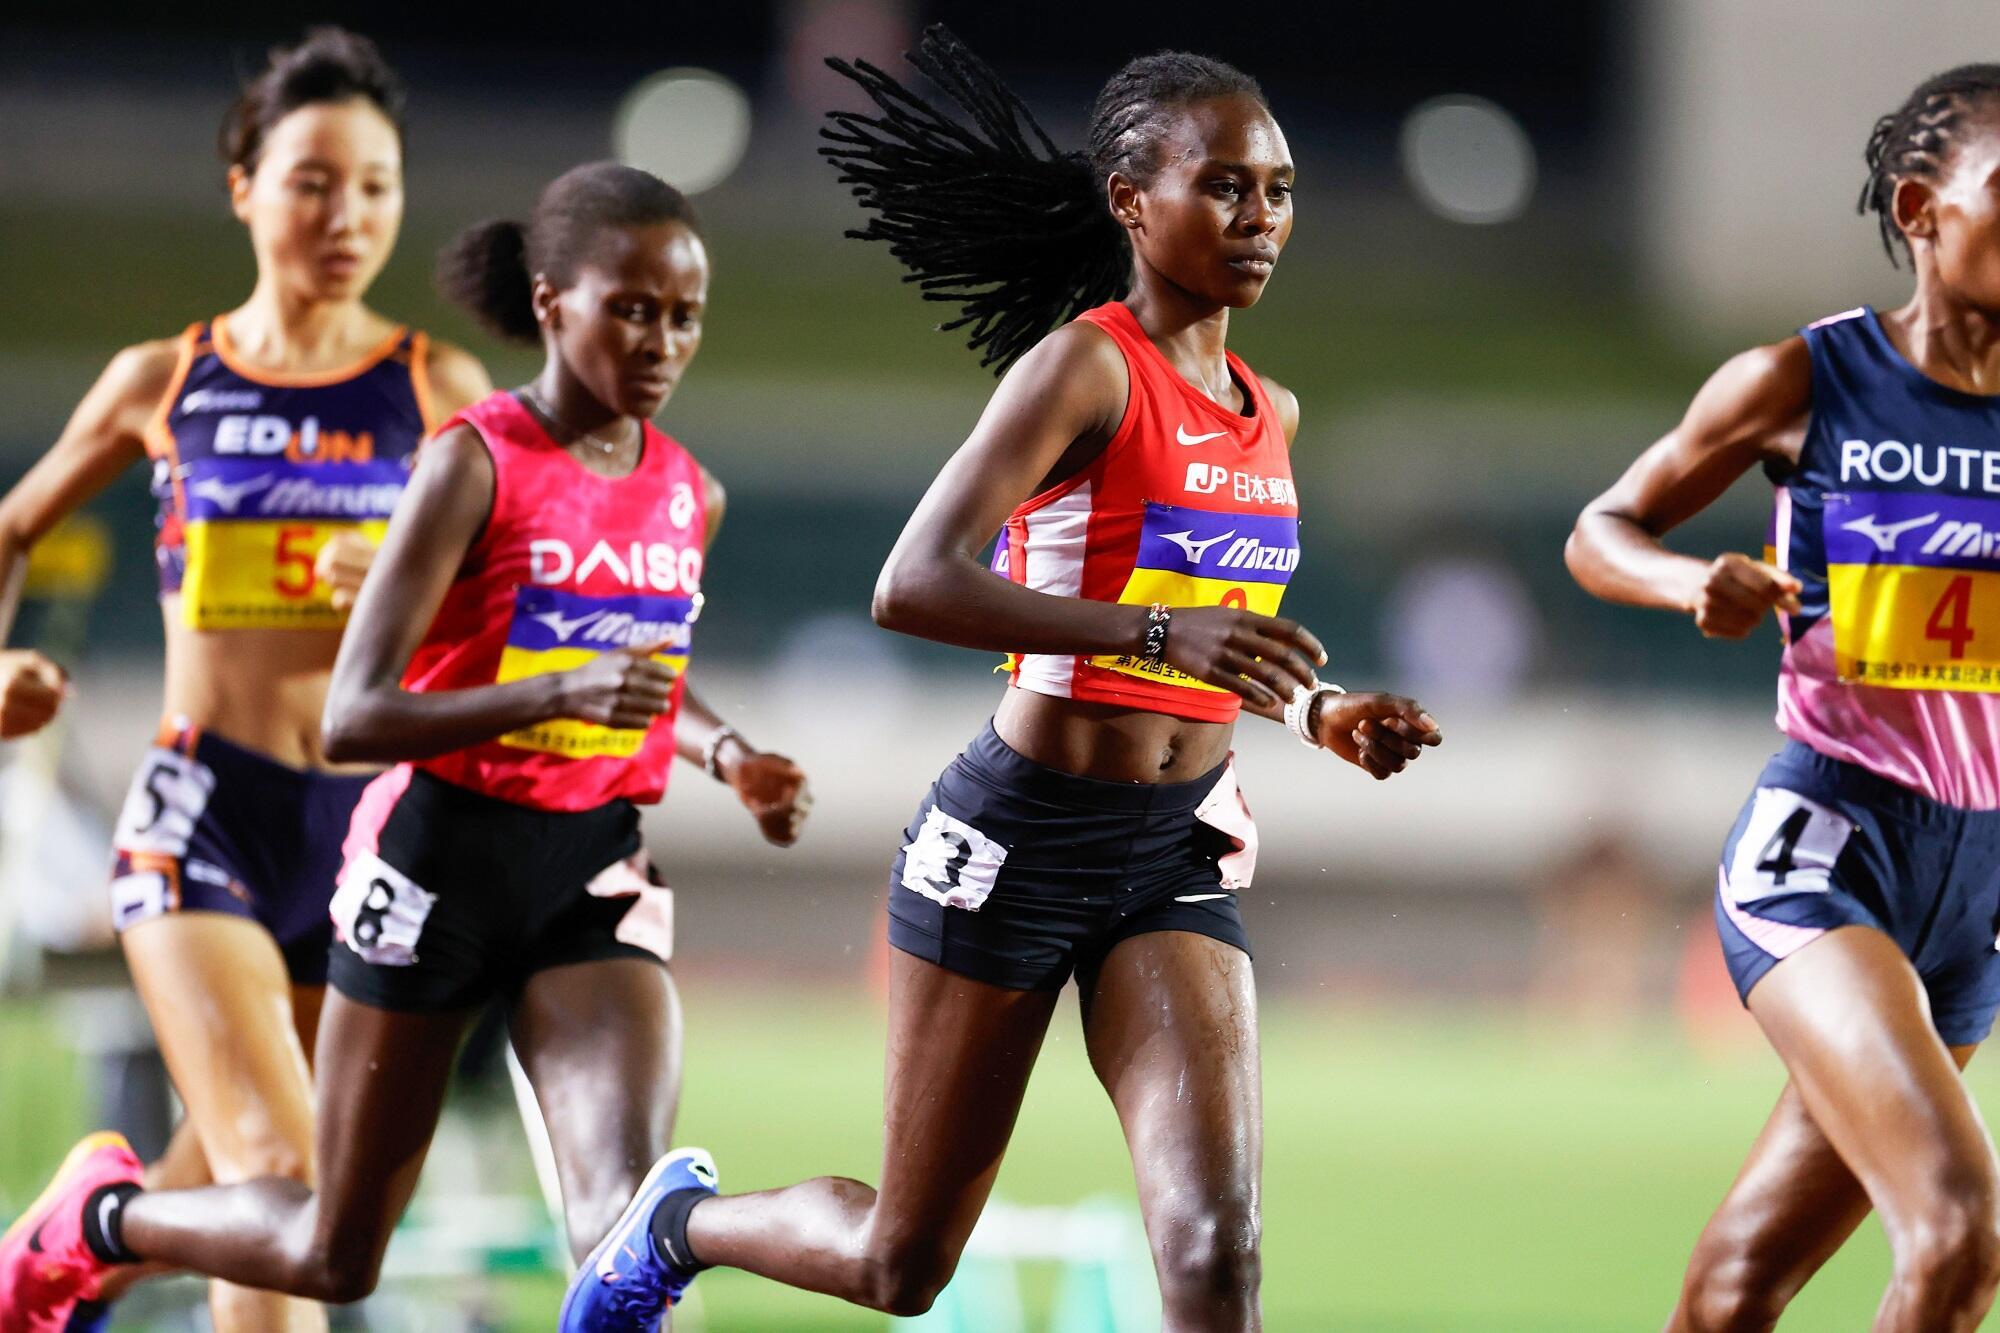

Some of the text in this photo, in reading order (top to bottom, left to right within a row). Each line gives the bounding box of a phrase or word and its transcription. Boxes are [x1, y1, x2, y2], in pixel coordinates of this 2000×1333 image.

[1184, 462, 1228, 494] JP
[1841, 439, 2000, 493] ROUTE
[272, 523, 318, 599] 5
[529, 539, 702, 594] DAISO
[1925, 575, 1975, 660] 4
[135, 763, 180, 834] 5
[1756, 806, 1813, 886] 4
[353, 877, 395, 948] 8
